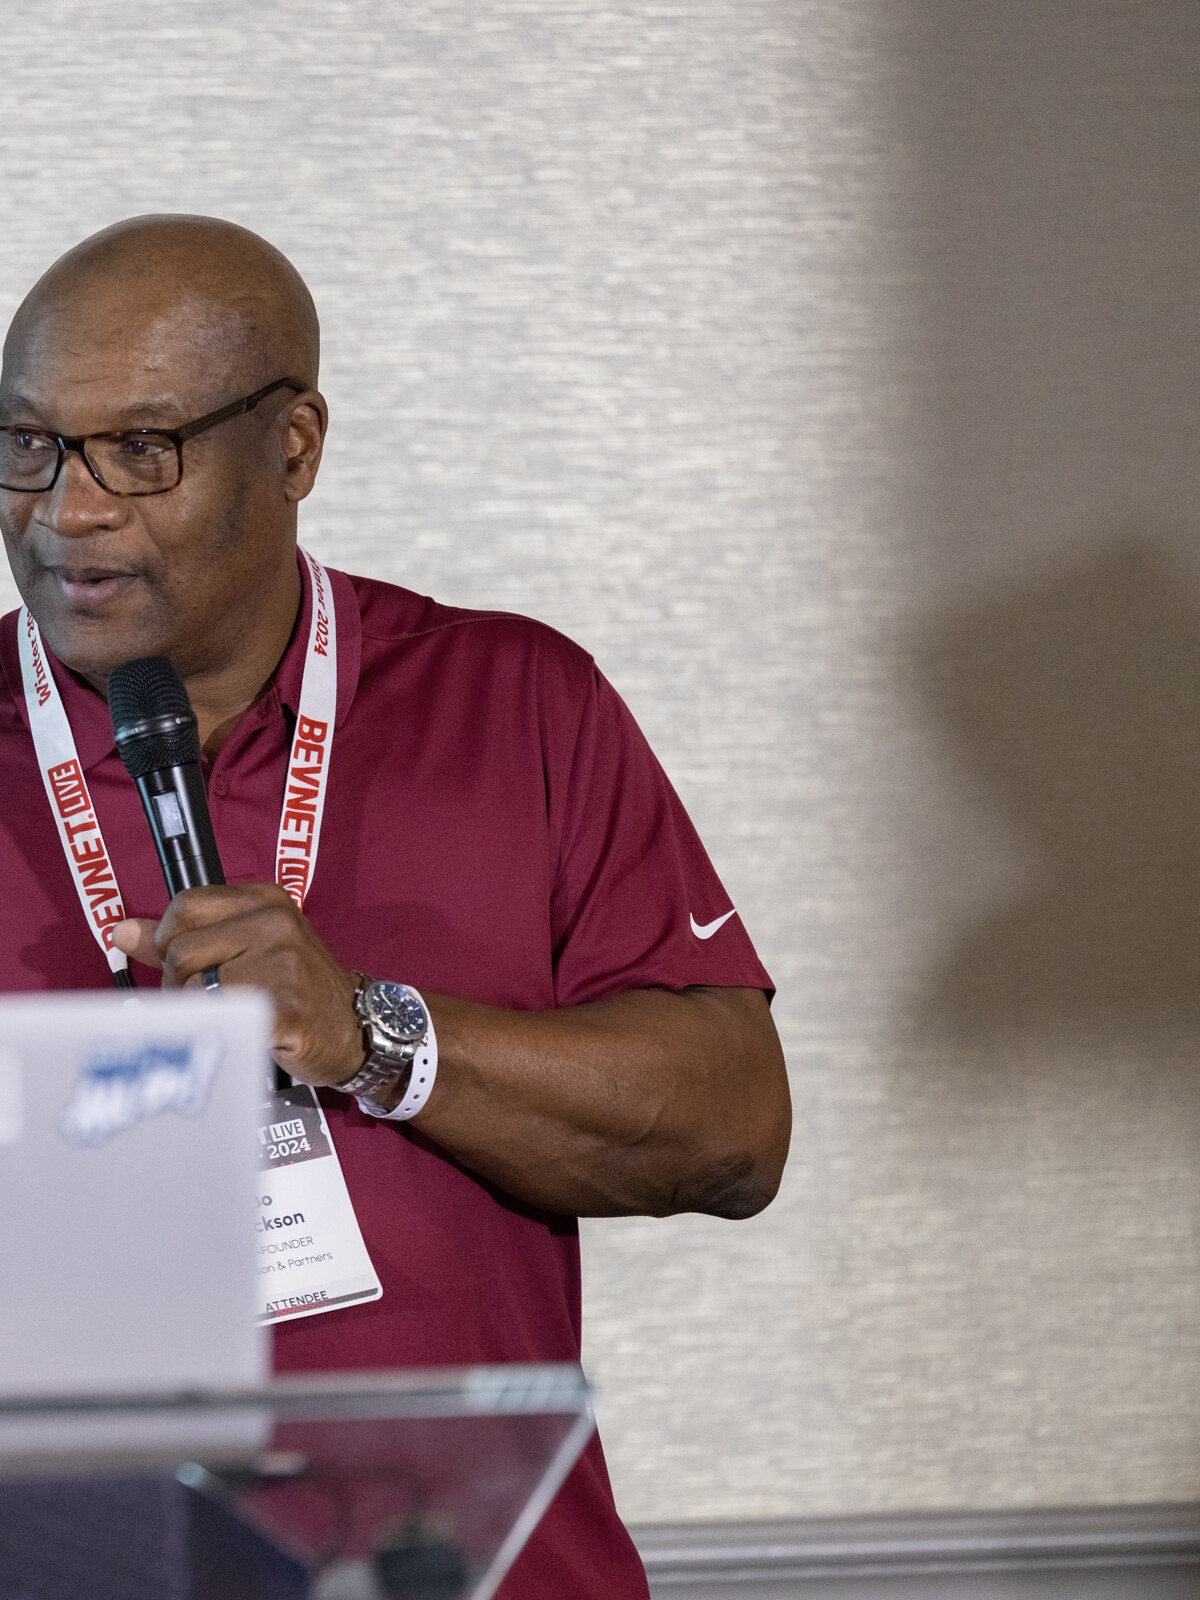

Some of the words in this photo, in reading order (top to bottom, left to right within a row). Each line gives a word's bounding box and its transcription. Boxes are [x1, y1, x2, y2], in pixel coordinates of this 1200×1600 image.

[314, 609, 329, 658] 2024
[31, 635, 52, 707] Winter
[267, 1137, 312, 1160] 2024
[255, 1212, 305, 1232] ckson
[277, 1261, 287, 1271] &
[288, 1252, 333, 1269] Partners
[266, 1290, 329, 1312] ATTENDEE
